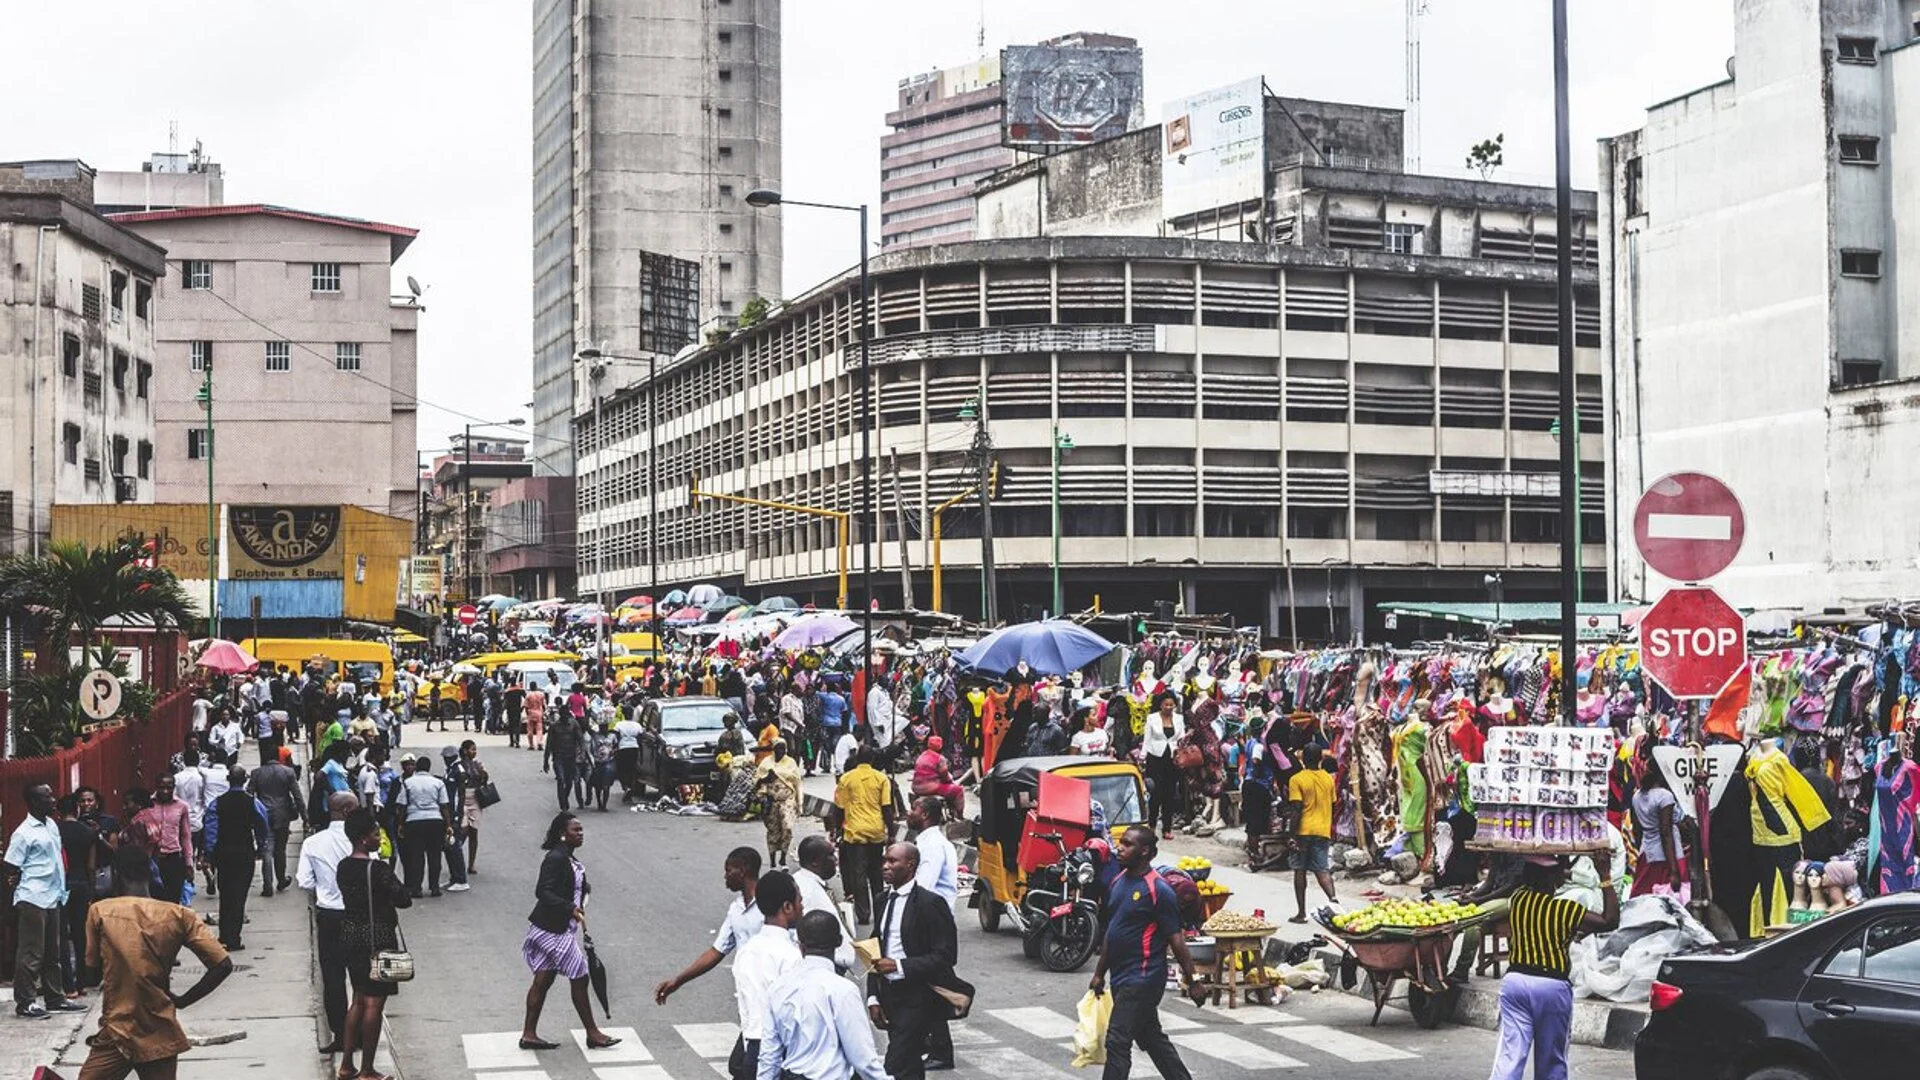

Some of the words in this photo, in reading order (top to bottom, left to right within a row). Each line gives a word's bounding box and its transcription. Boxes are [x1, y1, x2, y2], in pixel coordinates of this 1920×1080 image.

[271, 509, 298, 545] a
[240, 522, 329, 559] AMANDA'S
[235, 569, 285, 579] Clothes
[291, 568, 299, 577] &
[307, 568, 338, 578] Bags
[1650, 627, 1737, 657] STOP
[1674, 758, 1718, 778] GIVE
[1684, 783, 1713, 795] WY
